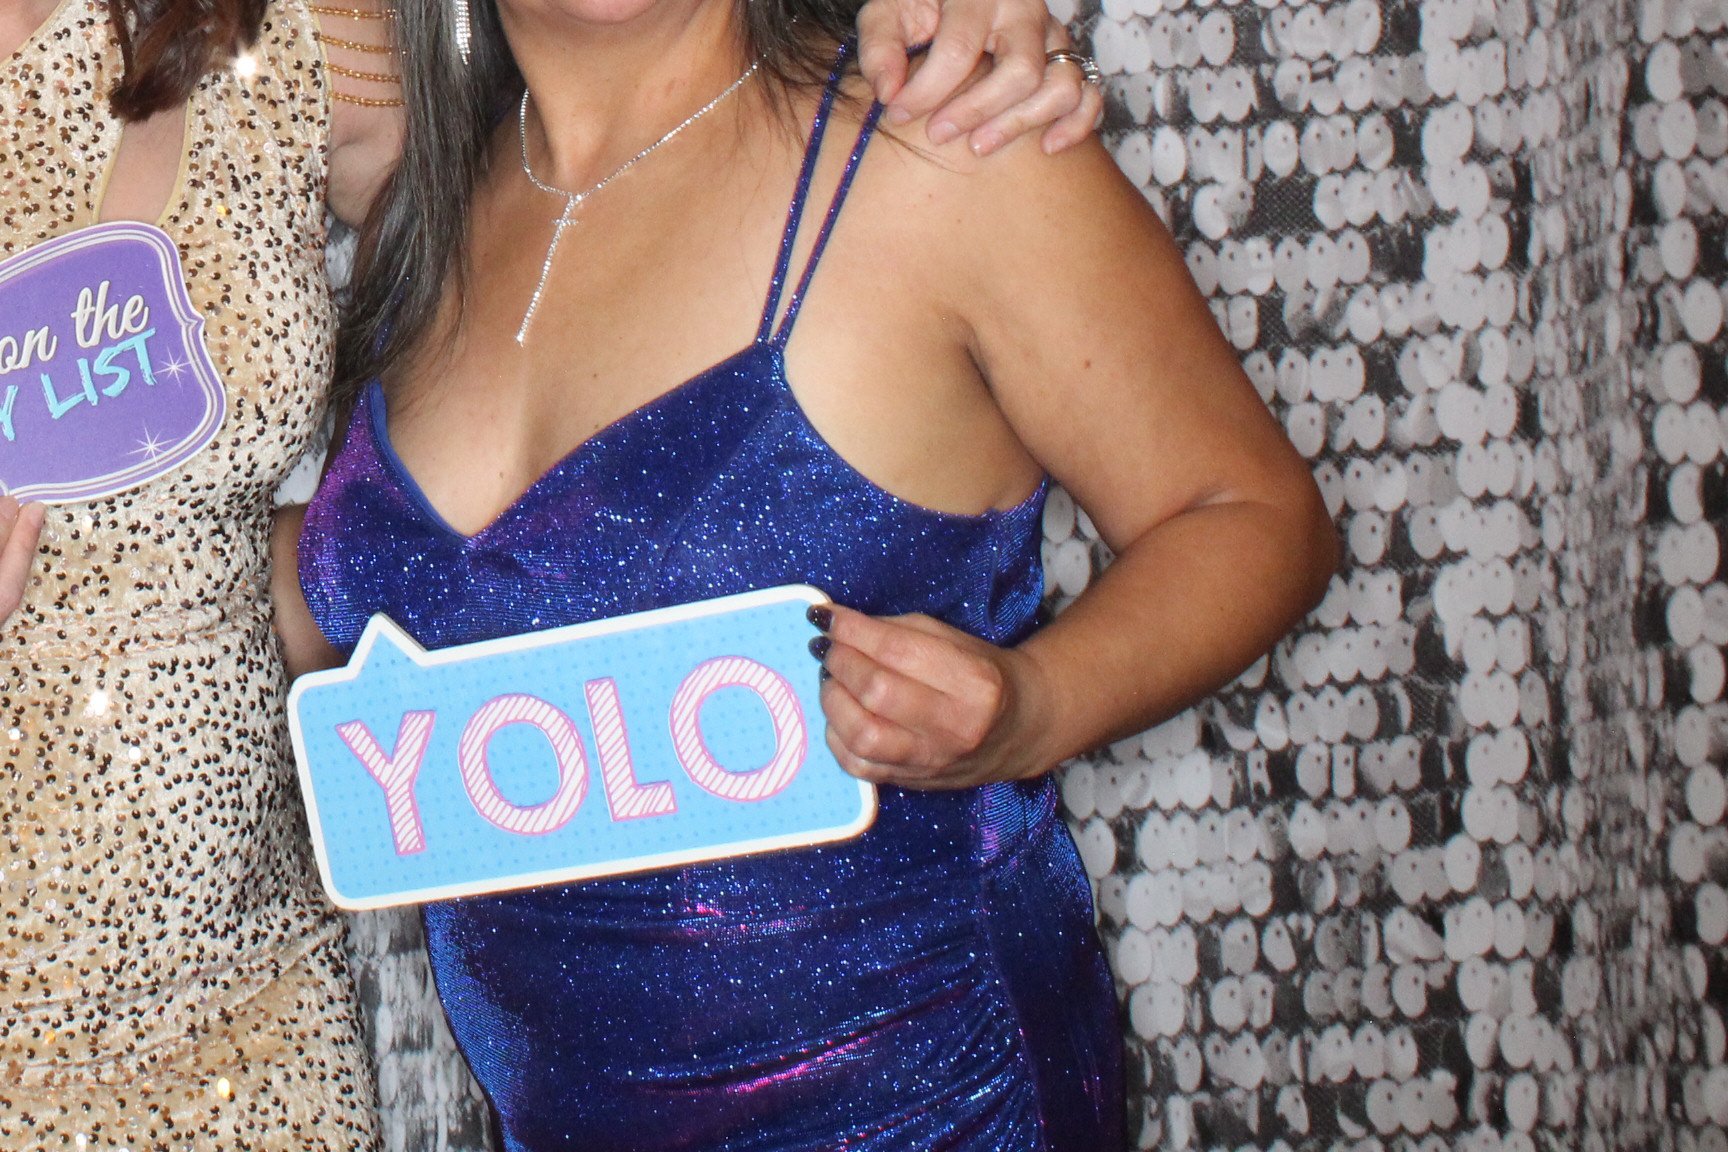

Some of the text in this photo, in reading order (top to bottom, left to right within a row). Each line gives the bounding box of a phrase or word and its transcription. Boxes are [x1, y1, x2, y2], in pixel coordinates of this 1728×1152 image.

[71, 280, 149, 348] the
[41, 328, 156, 420] LIST
[335, 655, 808, 855] YOLO
